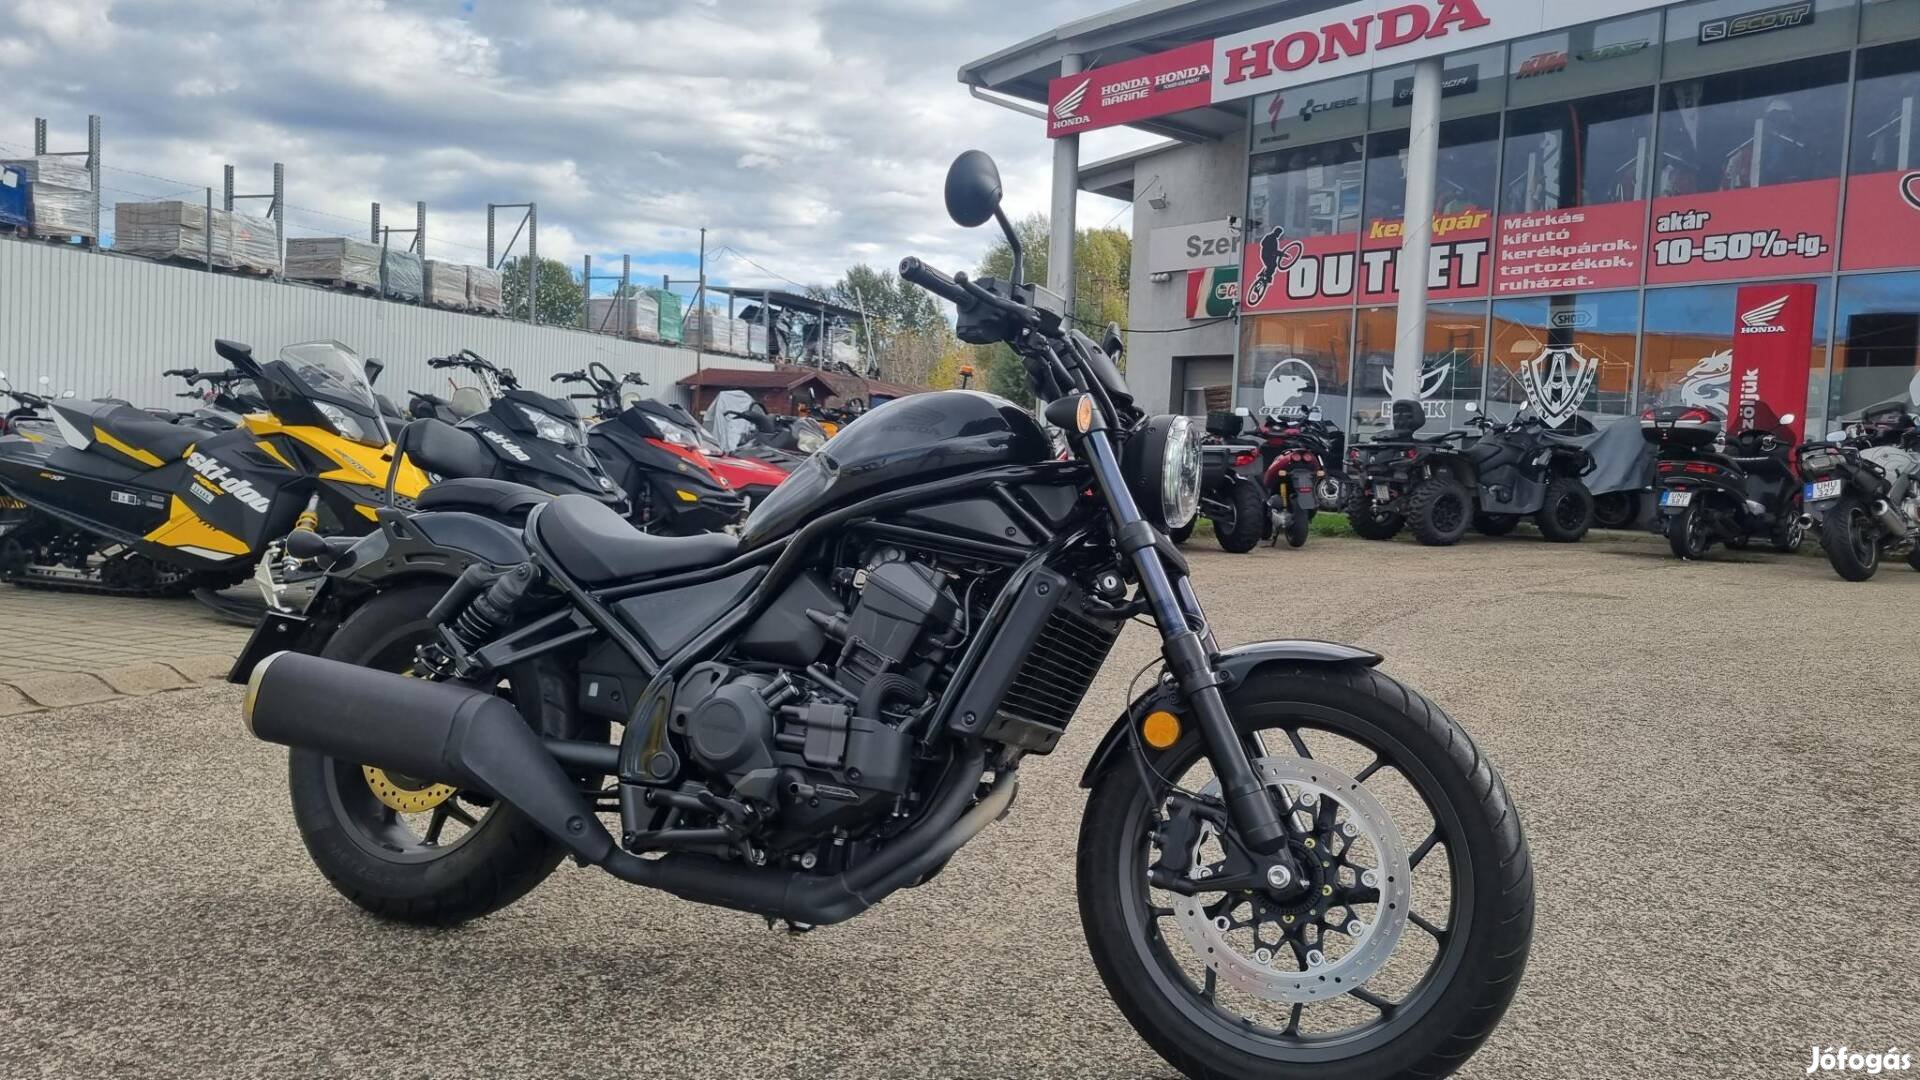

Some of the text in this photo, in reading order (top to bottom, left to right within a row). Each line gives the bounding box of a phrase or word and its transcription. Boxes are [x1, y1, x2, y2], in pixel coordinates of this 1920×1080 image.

[1730, 6, 1811, 36] SCOTT
[1223, 0, 1491, 85] HONDA
[1101, 76, 1151, 96] HONDA
[1154, 64, 1210, 87] HONDA
[1102, 88, 1150, 108] MARINE
[1311, 96, 1360, 114] CUBE
[1052, 115, 1091, 130] HONDA
[1503, 212, 1585, 230] Márkás
[1656, 209, 1710, 233] akár
[1502, 228, 1570, 246] kifutó
[1654, 229, 1828, 266] 10-50%-ig.
[1501, 238, 1638, 261] kerékpárok,
[1287, 239, 1489, 300] OUTET
[1499, 255, 1634, 276] tartozékok,
[1499, 274, 1595, 292] ruházat.
[1741, 325, 1786, 334] HONDA
[1738, 367, 1760, 434] zöljük
[186, 451, 271, 514] ski-doo
